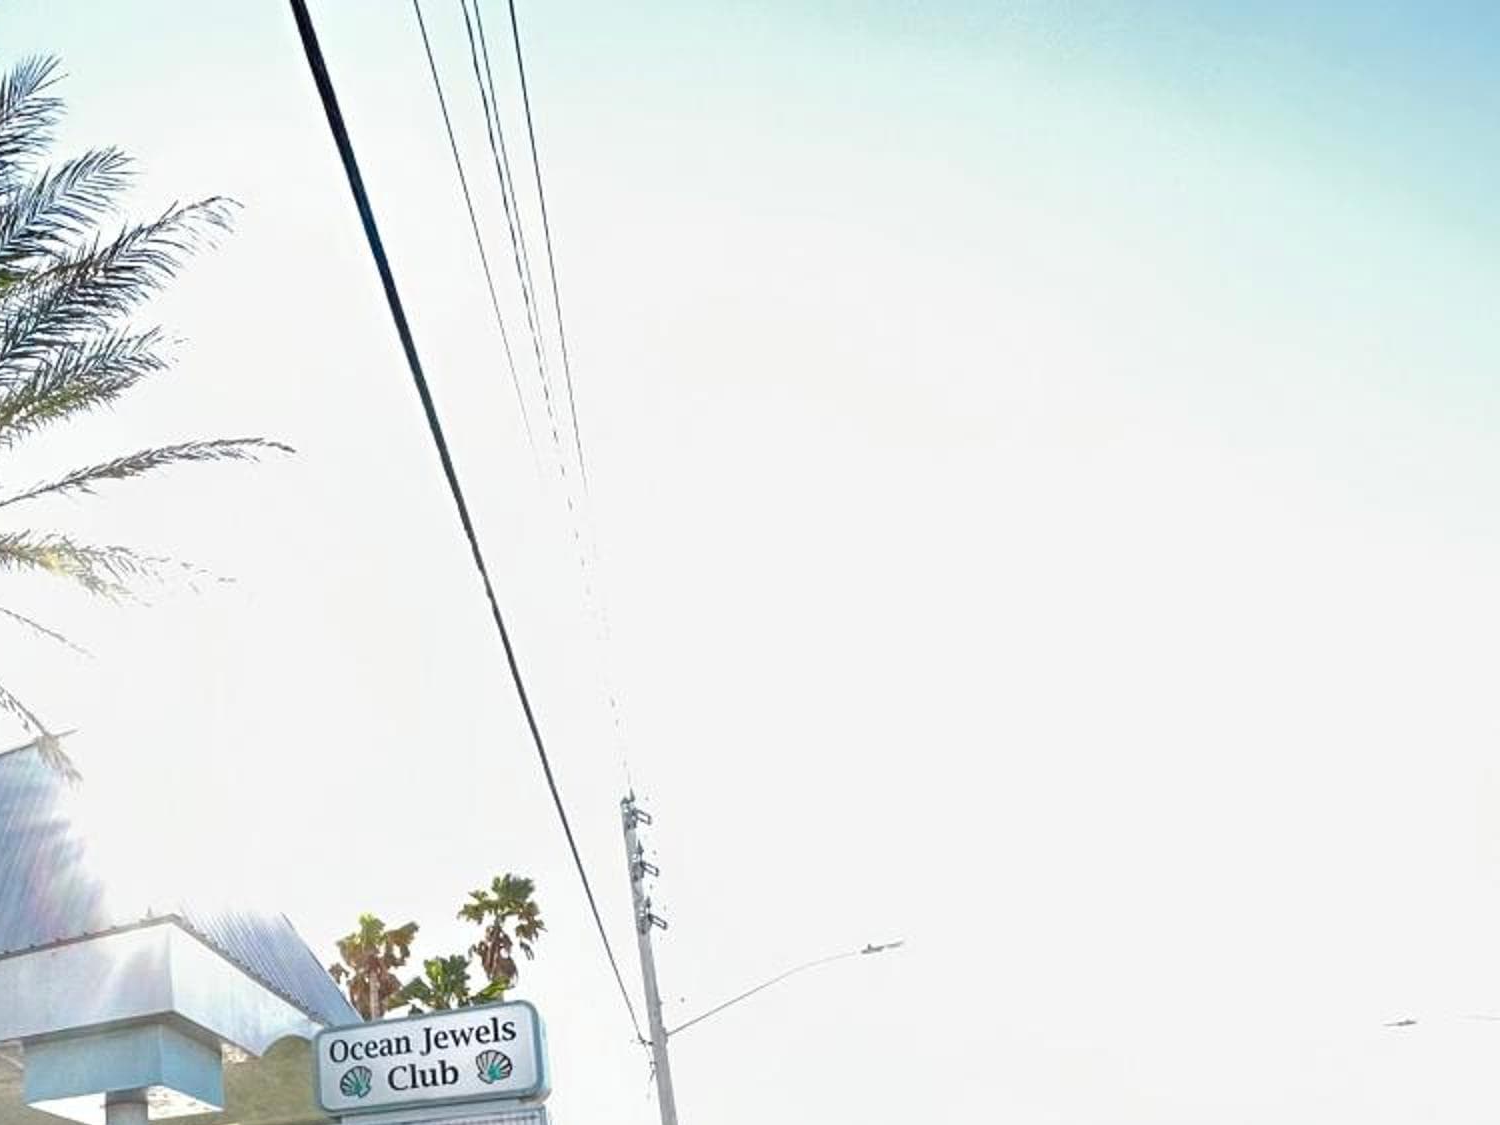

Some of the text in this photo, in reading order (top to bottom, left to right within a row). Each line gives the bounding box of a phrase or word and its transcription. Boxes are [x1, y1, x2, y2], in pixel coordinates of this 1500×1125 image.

[329, 1017, 517, 1063] Ocean Jewels
[387, 1060, 460, 1091] Club
